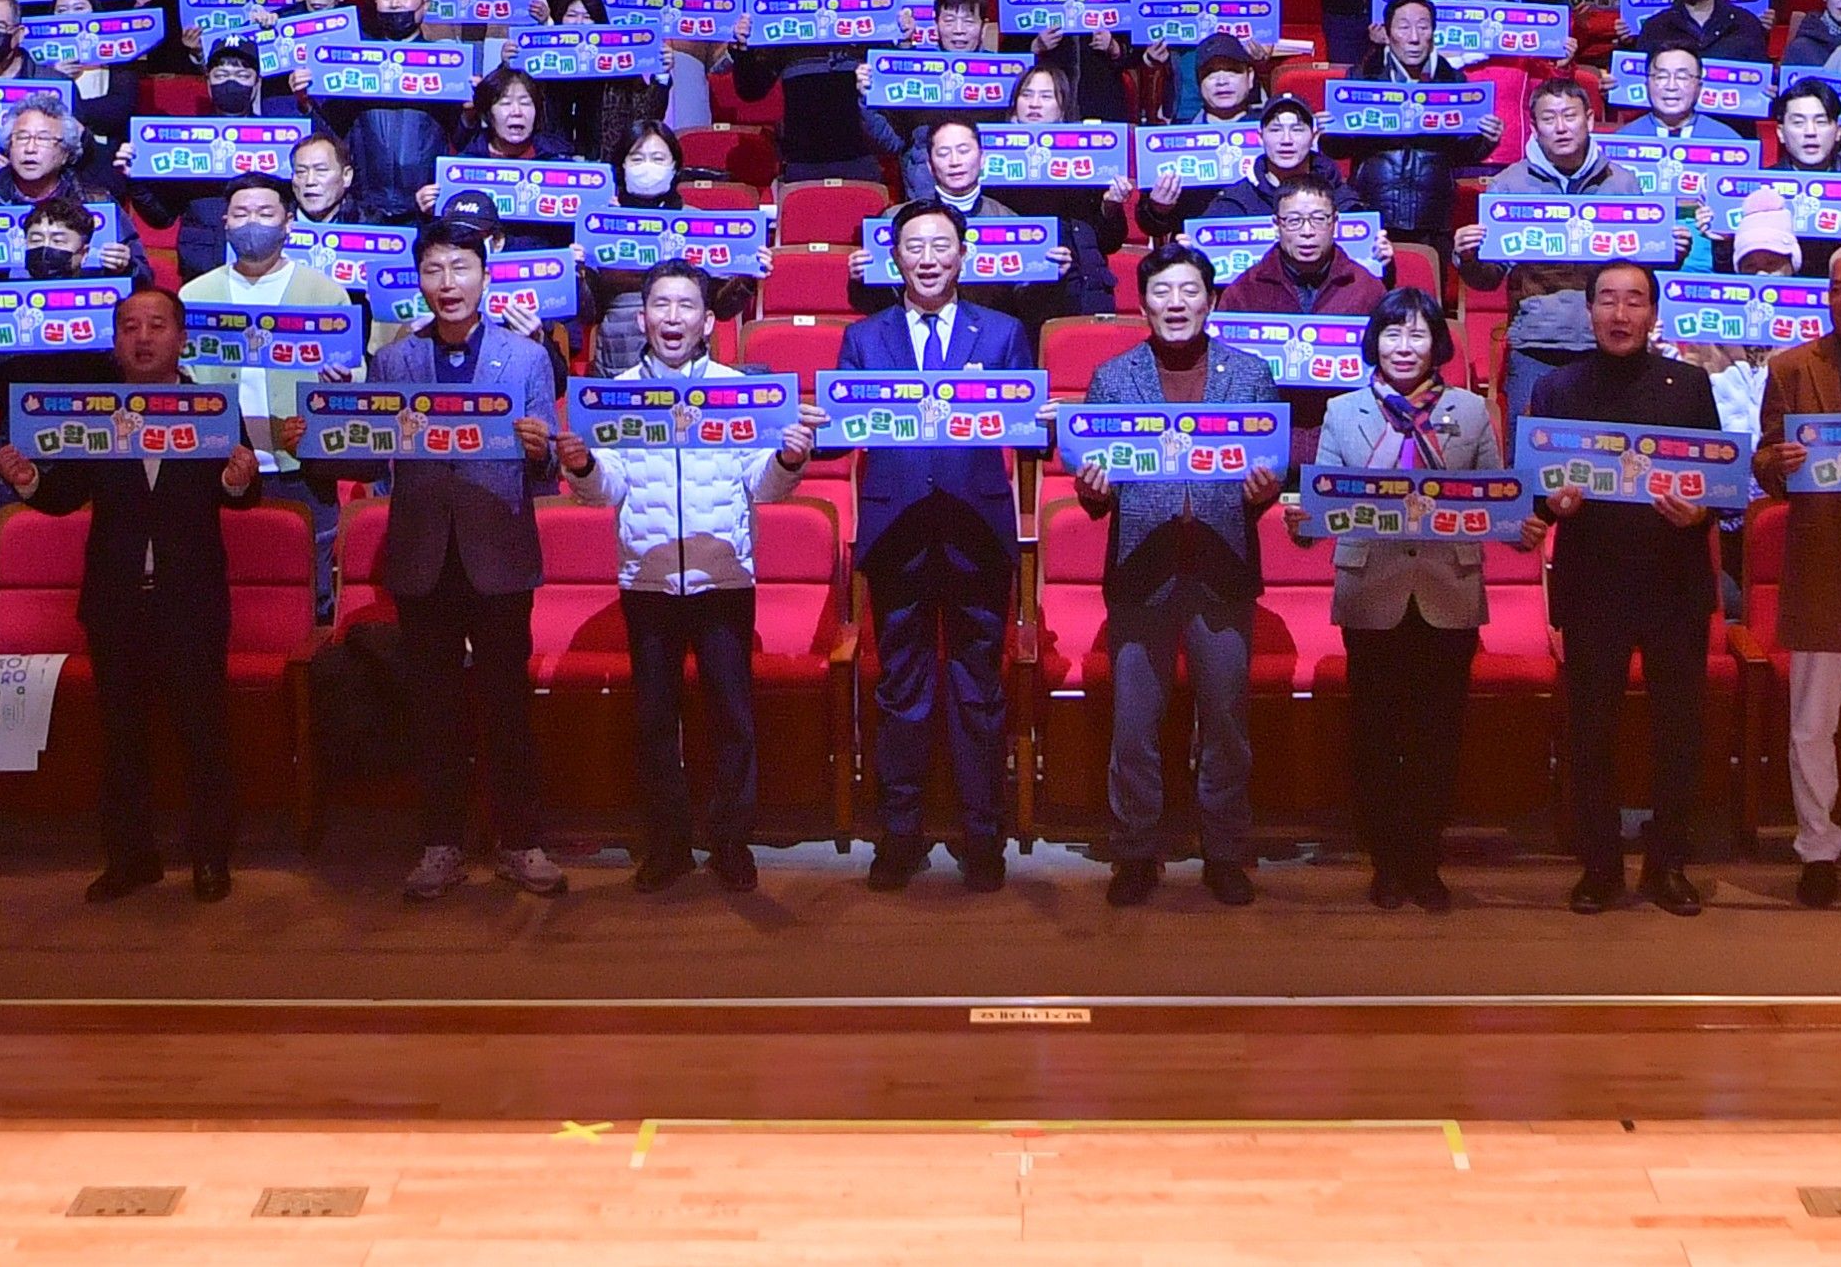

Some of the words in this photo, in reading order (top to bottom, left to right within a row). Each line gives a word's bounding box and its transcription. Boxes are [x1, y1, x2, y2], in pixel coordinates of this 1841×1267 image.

[765, 19, 814, 39] 다함께
[836, 18, 872, 36] 실천
[326, 70, 378, 91] 다함께
[401, 75, 439, 92] 실천
[887, 80, 939, 101] 다함께
[963, 84, 1001, 101] 실천
[1346, 109, 1398, 129] 다함께
[153, 149, 209, 171] 다함께
[234, 152, 275, 170] 실천
[597, 240, 657, 263] 다함께
[684, 245, 727, 264] 실천
[1503, 229, 1564, 253] 다함께
[1592, 233, 1636, 253] 실천
[43, 319, 92, 342] 실천
[322, 423, 394, 451] 다함께
[427, 427, 479, 450] 실천
[595, 416, 668, 444] 다함께
[700, 418, 753, 441] 실천
[845, 411, 916, 439] 다함께
[949, 414, 1001, 437] 실천
[38, 424, 110, 452] 다함께
[142, 426, 195, 450] 실천
[1190, 447, 1243, 471] 실천
[1542, 461, 1616, 493] 다함께
[1648, 472, 1702, 497] 실천
[1327, 505, 1401, 532] 다함께
[1433, 510, 1487, 533] 실천
